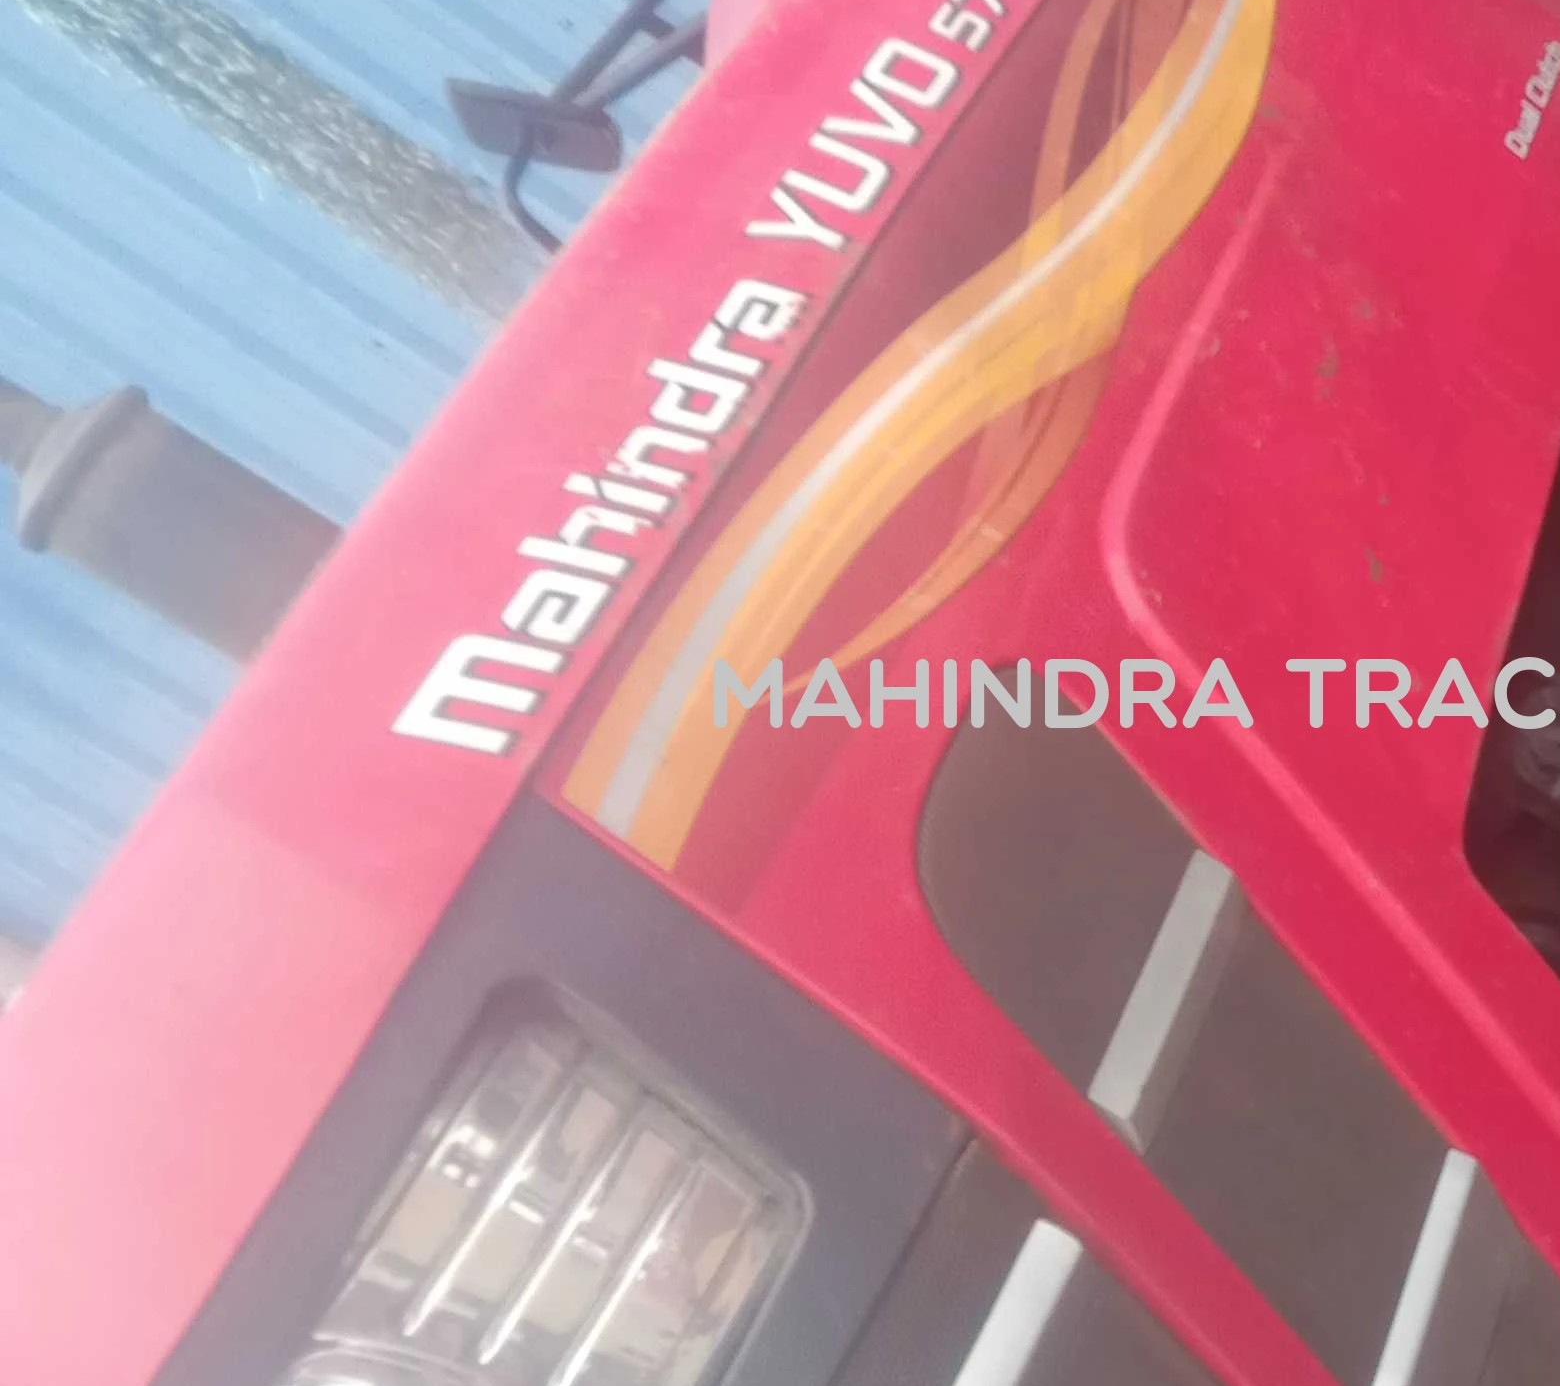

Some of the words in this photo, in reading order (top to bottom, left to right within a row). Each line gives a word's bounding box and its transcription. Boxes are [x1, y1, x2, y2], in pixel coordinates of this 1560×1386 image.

[1503, 98, 1543, 160] Dual
[390, 277, 808, 756] Mahindra
[744, 35, 962, 253] YUVO
